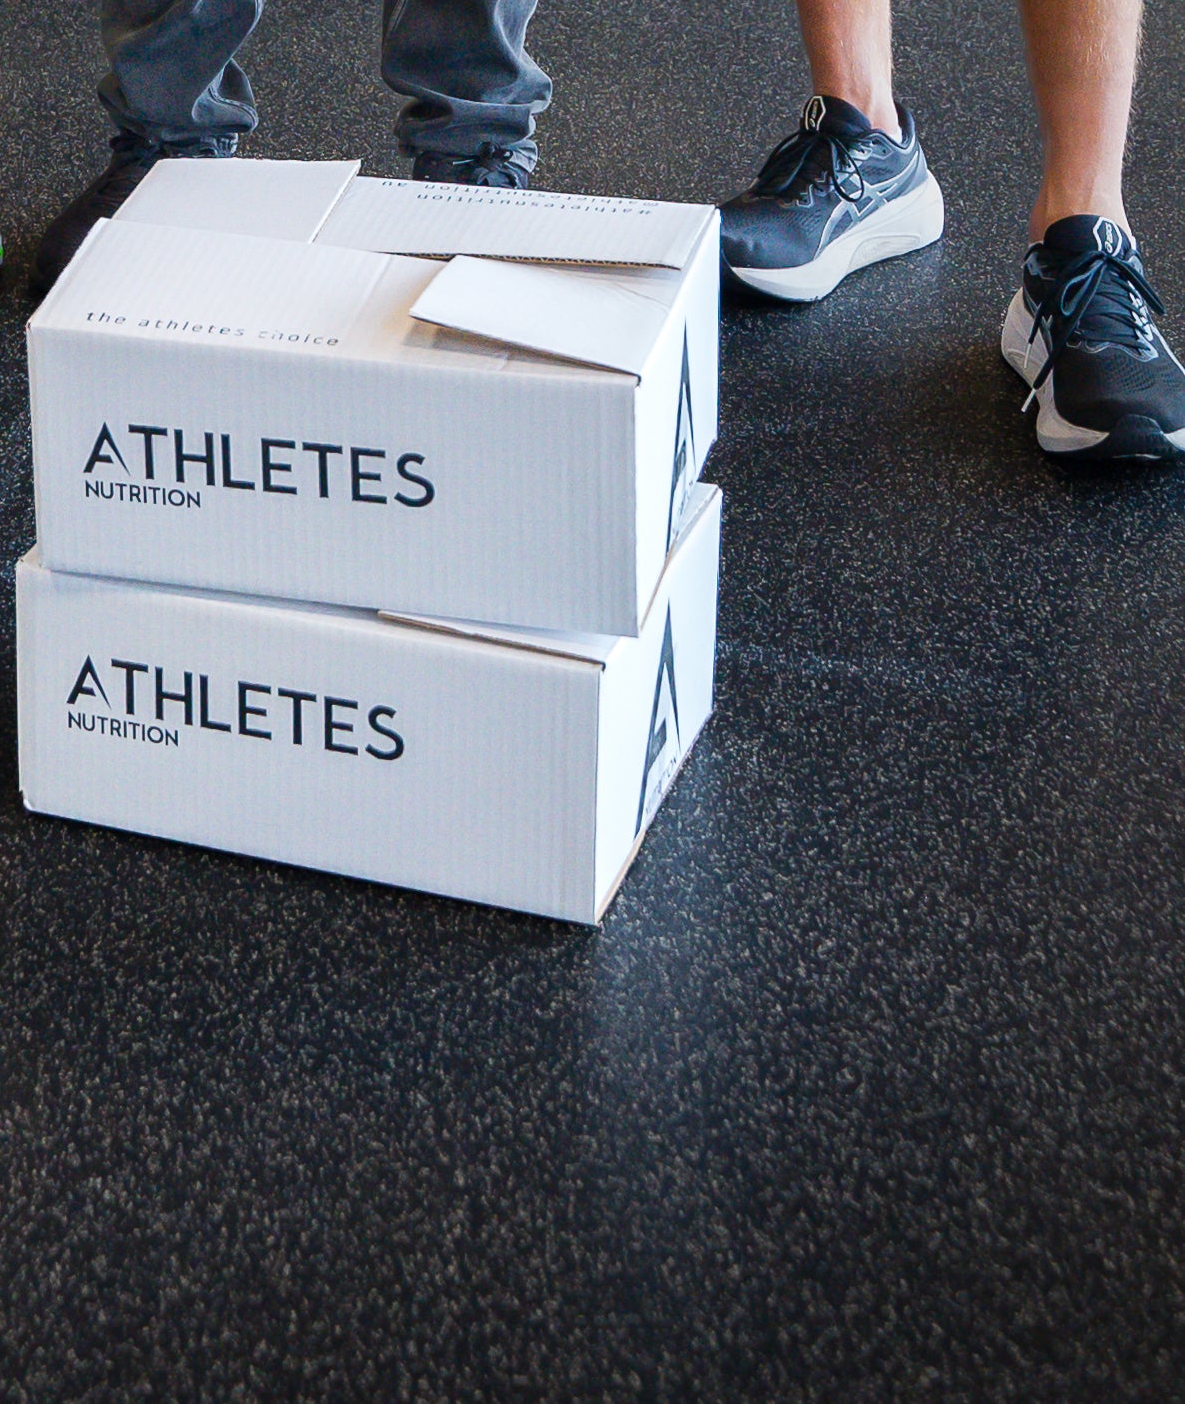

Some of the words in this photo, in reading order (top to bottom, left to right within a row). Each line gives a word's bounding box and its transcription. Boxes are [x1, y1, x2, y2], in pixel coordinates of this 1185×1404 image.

[86, 311, 127, 325] the
[138, 318, 246, 337] athletes
[258, 329, 340, 347] choice
[83, 422, 436, 508] ATHLETES
[84, 479, 201, 508] NUTRITION
[65, 654, 405, 761] ATHLETES
[68, 710, 179, 747] NUTRITION
